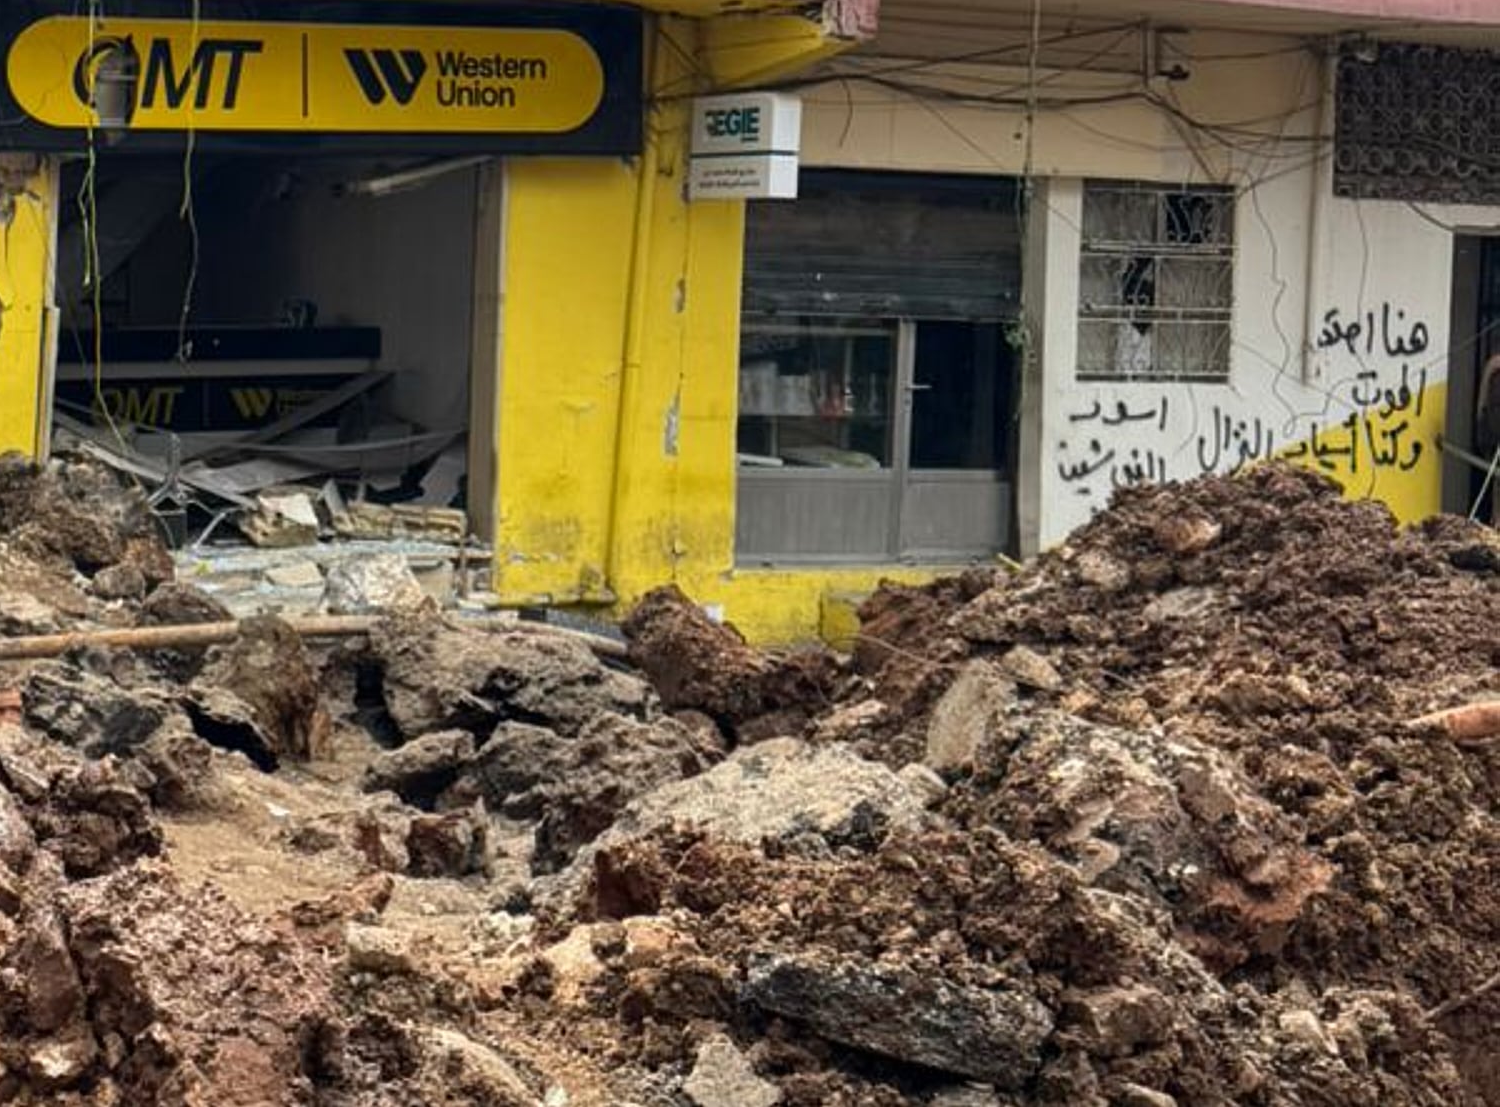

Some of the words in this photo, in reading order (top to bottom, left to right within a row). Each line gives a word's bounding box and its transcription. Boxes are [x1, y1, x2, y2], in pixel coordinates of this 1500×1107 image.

[435, 50, 547, 80] Western
[436, 79, 516, 107] Union
[1382, 301, 1429, 357] هنا
